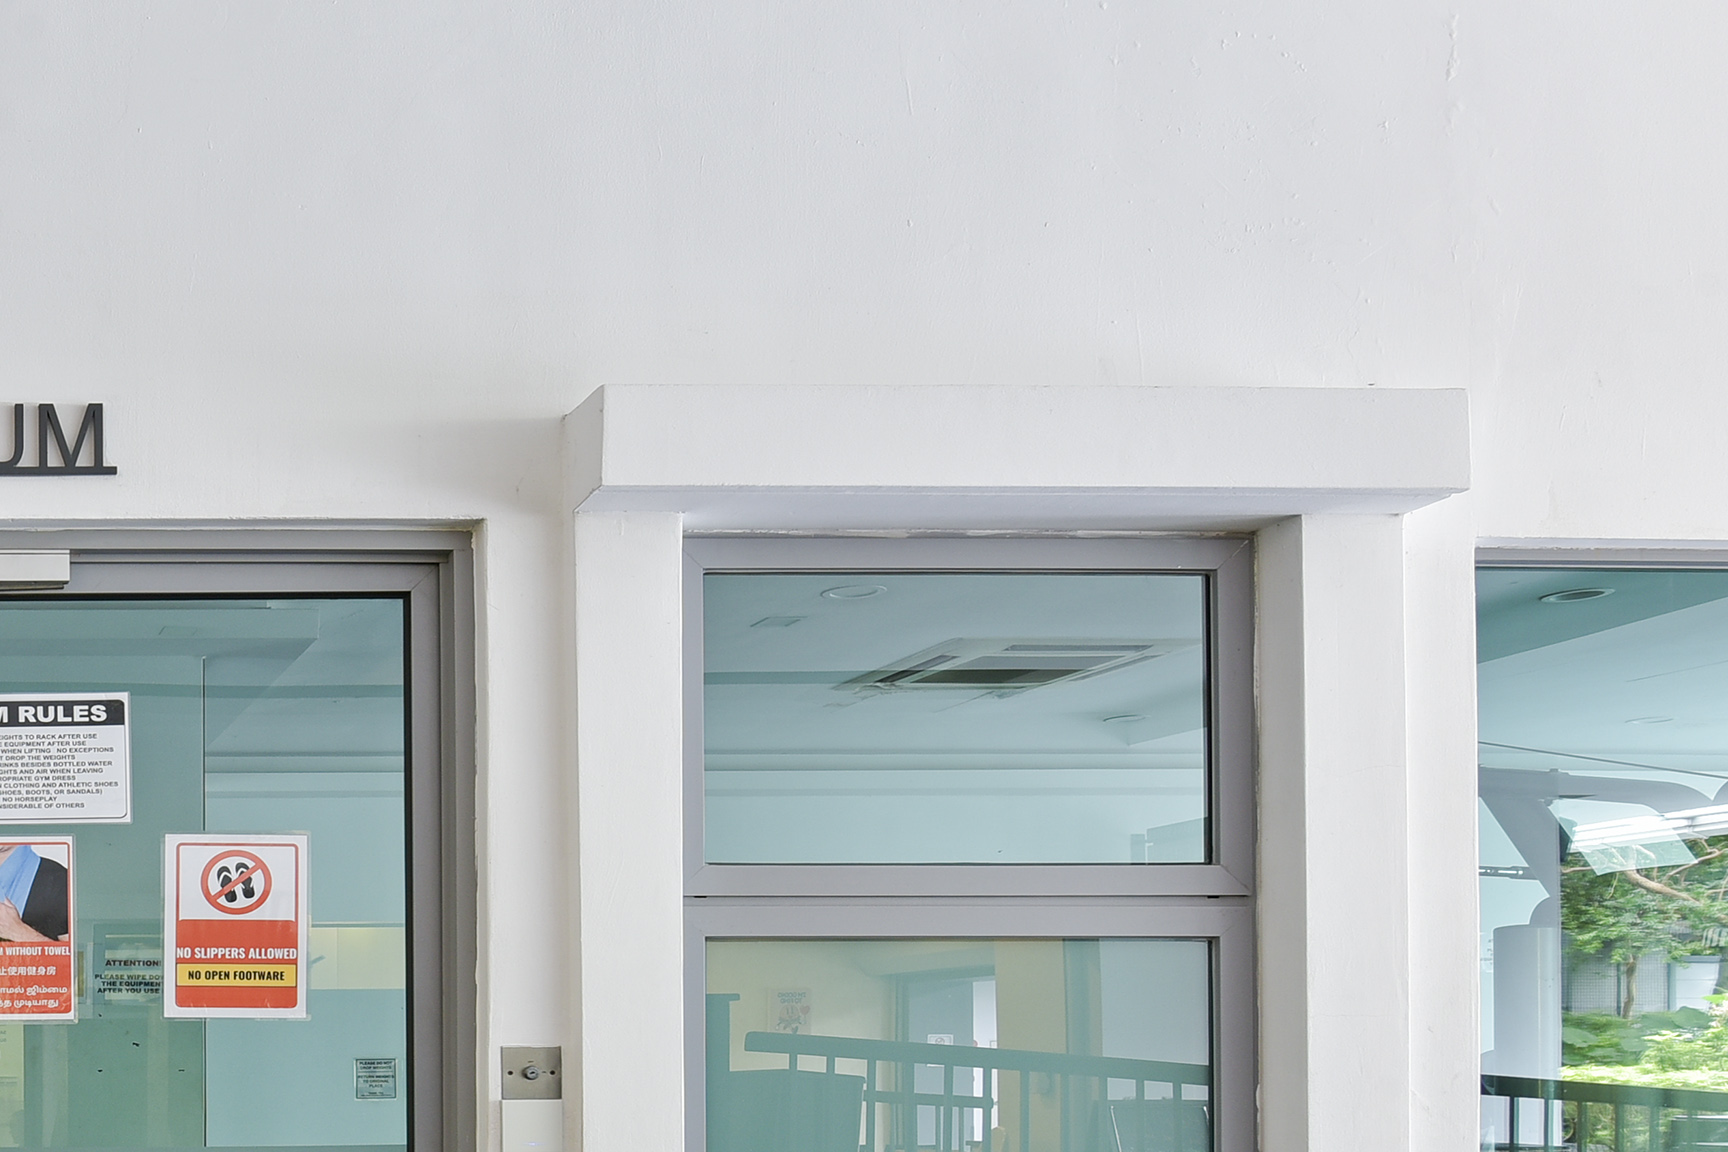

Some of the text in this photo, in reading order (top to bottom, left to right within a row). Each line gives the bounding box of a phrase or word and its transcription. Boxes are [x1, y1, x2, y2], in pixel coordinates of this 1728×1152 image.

[18, 705, 107, 722] RULES
[5, 946, 42, 955] WITHOUT
[44, 946, 70, 955] TOWEL
[176, 947, 297, 960] NO SLIPPERS ALLOWED
[188, 970, 285, 980] NO OPEN FOOTWARE
